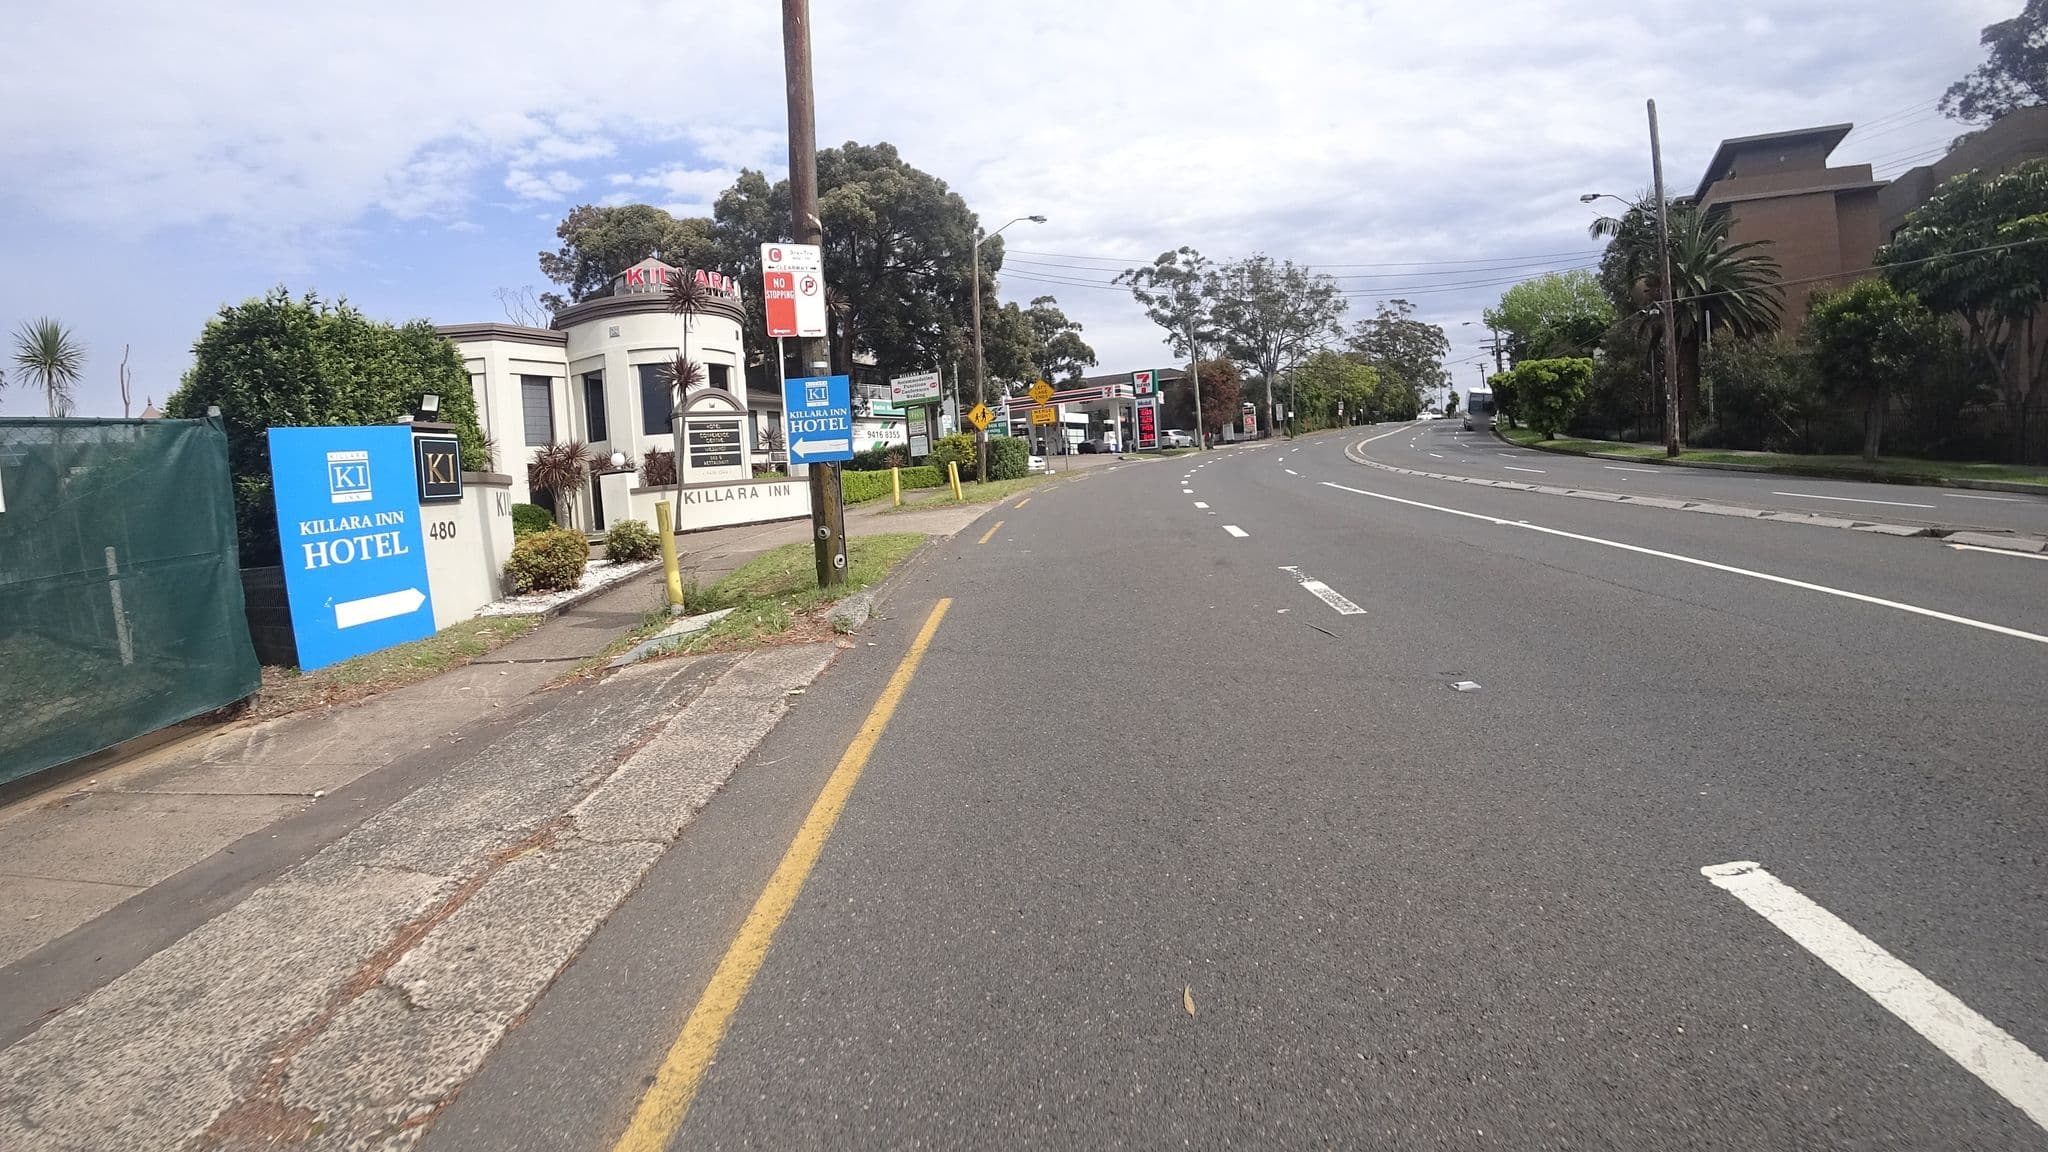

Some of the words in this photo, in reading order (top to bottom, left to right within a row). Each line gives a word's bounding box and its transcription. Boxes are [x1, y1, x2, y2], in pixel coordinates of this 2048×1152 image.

[626, 267, 734, 294] KILARA
[773, 278, 786, 289] NO
[766, 290, 794, 299] STOPPING
[808, 388, 826, 400] KI
[790, 410, 829, 419] KILLARA
[830, 408, 848, 416] INN
[790, 417, 849, 433] HOTEL
[867, 431, 884, 439] 9416
[333, 466, 367, 488] KI
[425, 453, 457, 484] KI
[684, 486, 759, 504] KILLARA
[768, 484, 791, 497] INN
[300, 515, 373, 536] KILLARA
[375, 511, 405, 526] INN
[430, 521, 456, 540] 480
[302, 531, 408, 569] HOTEL
